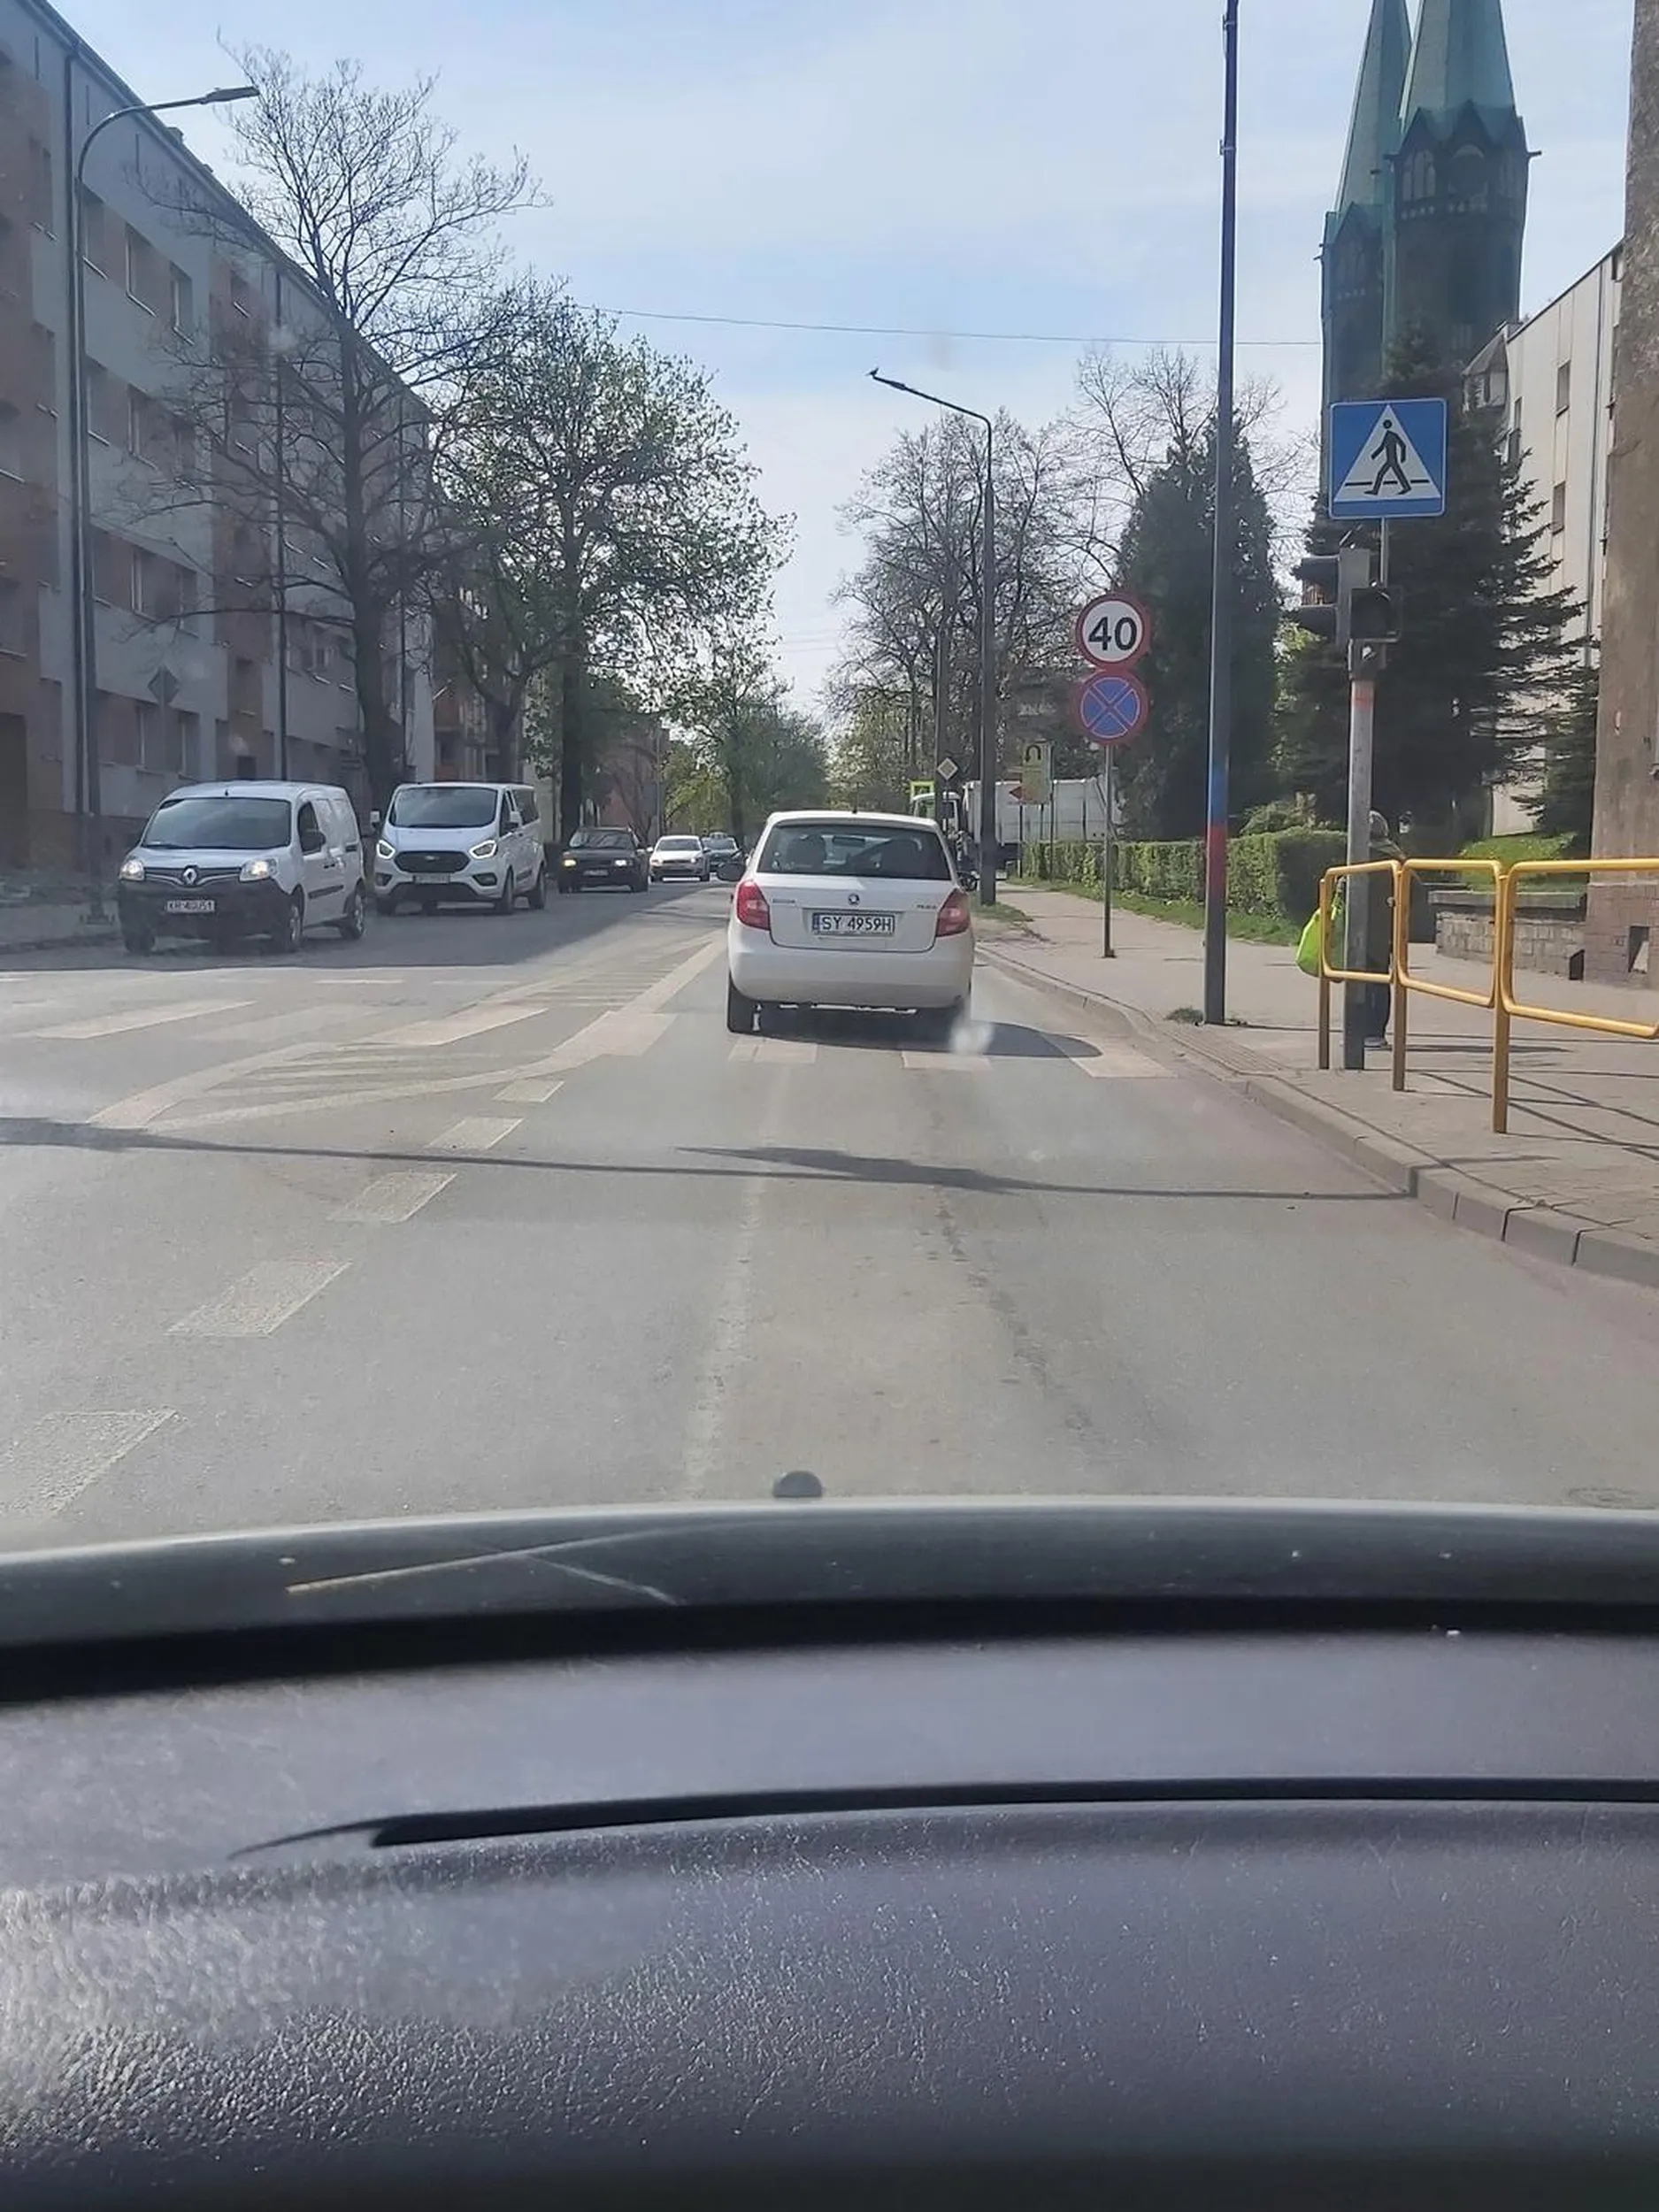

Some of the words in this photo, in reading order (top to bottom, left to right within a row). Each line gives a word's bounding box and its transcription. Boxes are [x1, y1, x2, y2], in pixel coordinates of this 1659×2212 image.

[1088, 617, 1137, 650] 40
[821, 916, 841, 930] SY
[847, 917, 892, 932] 4959H
